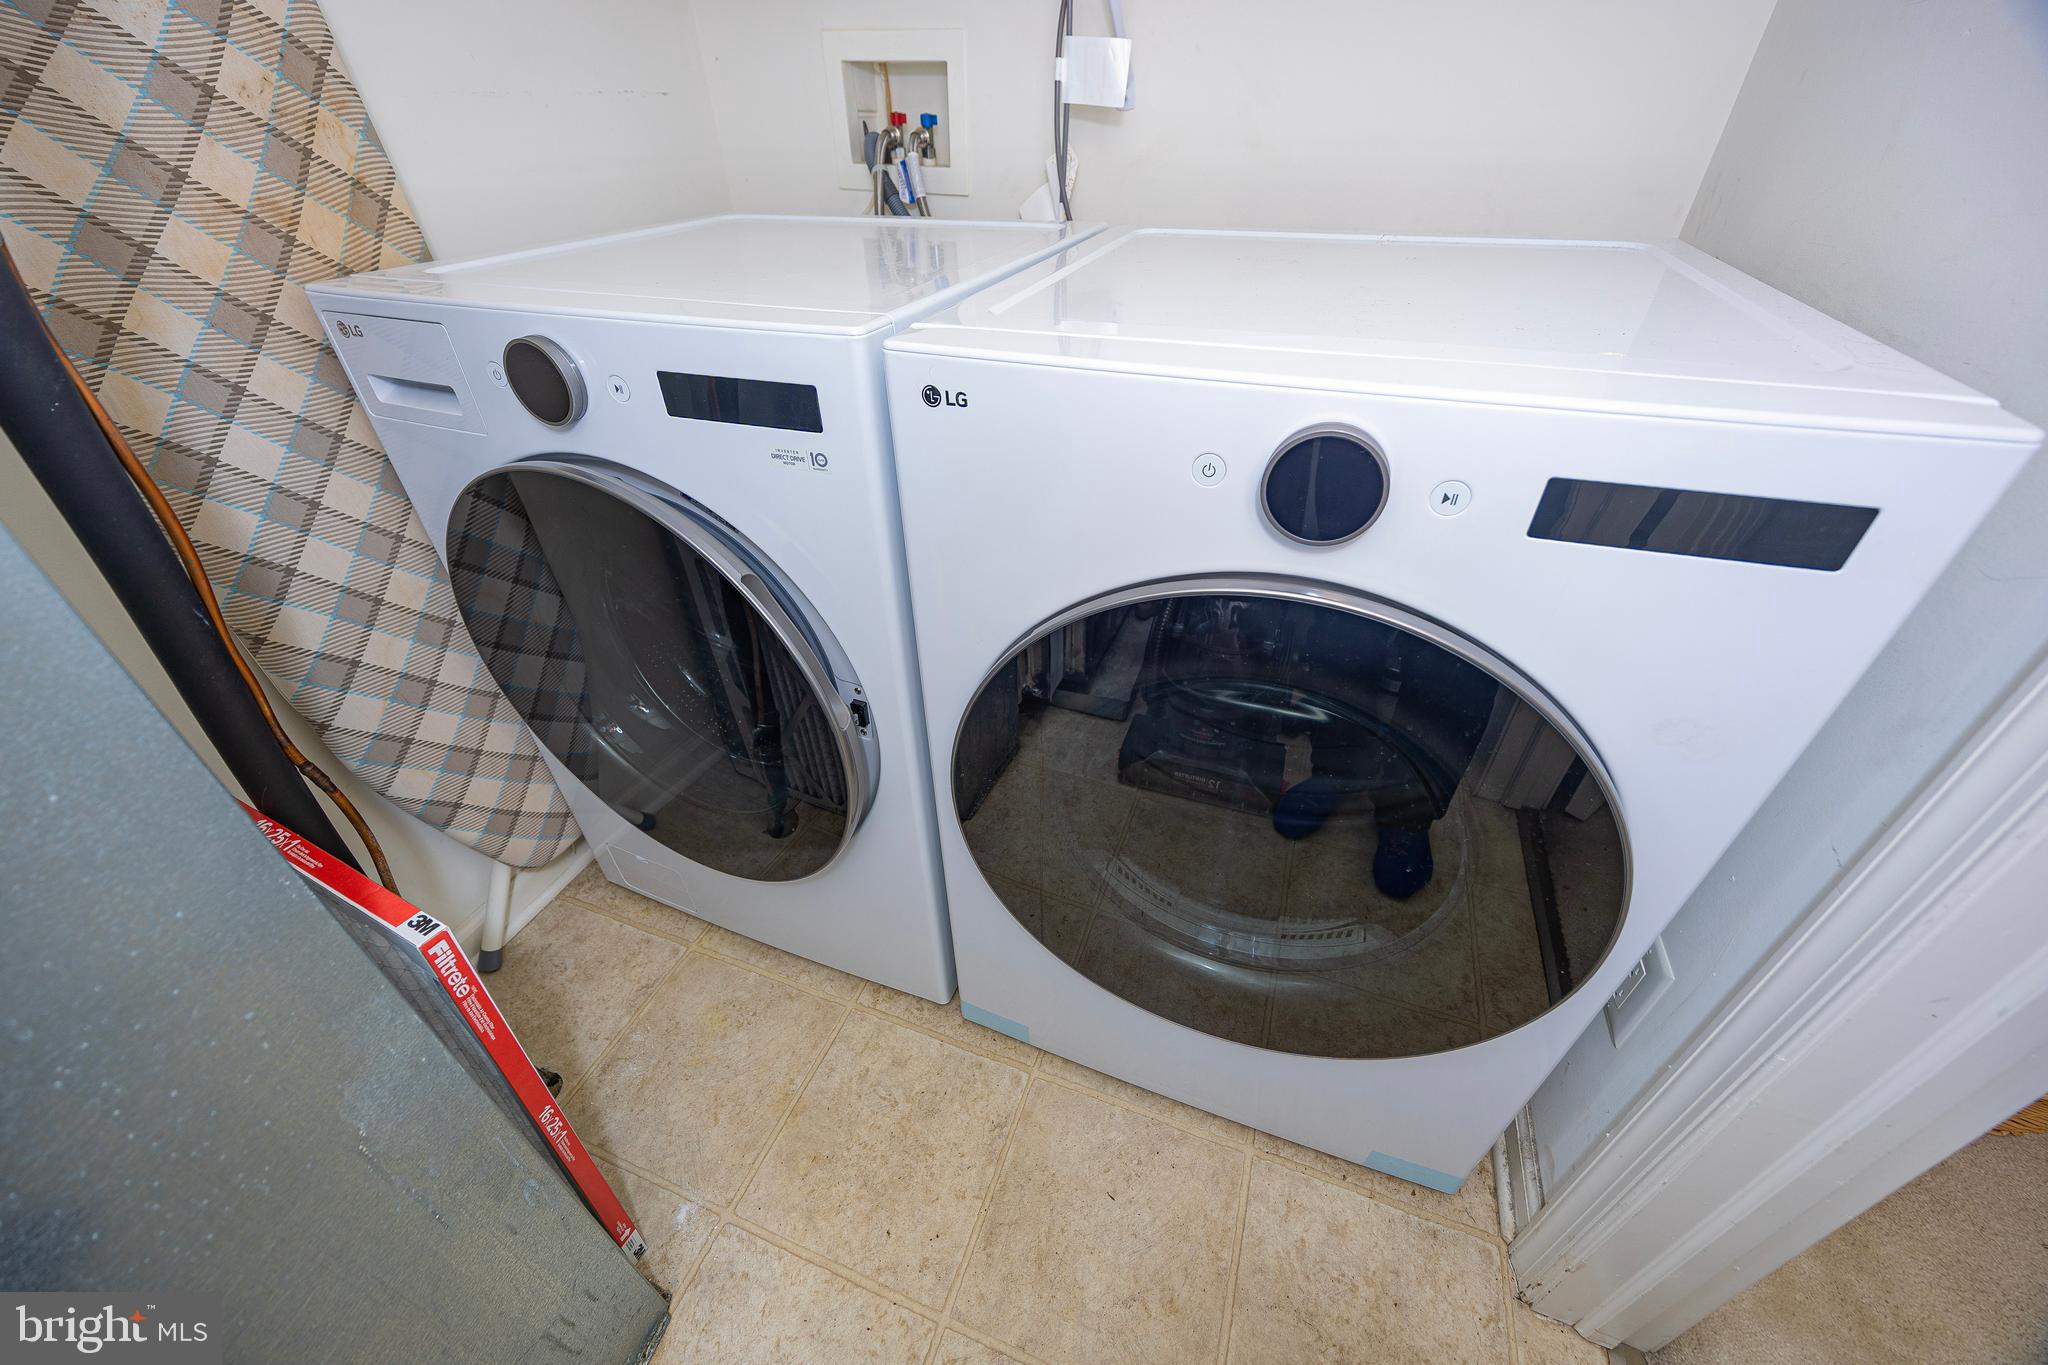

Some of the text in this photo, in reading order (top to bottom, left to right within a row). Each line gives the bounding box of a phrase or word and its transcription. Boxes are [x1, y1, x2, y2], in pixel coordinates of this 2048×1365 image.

[348, 324, 364, 338] LG
[945, 390, 968, 407] LG
[771, 452, 806, 463] DIRECT DRIVE
[809, 451, 828, 468] 10
[407, 914, 441, 937] 3M
[427, 939, 470, 998] Filtrete
